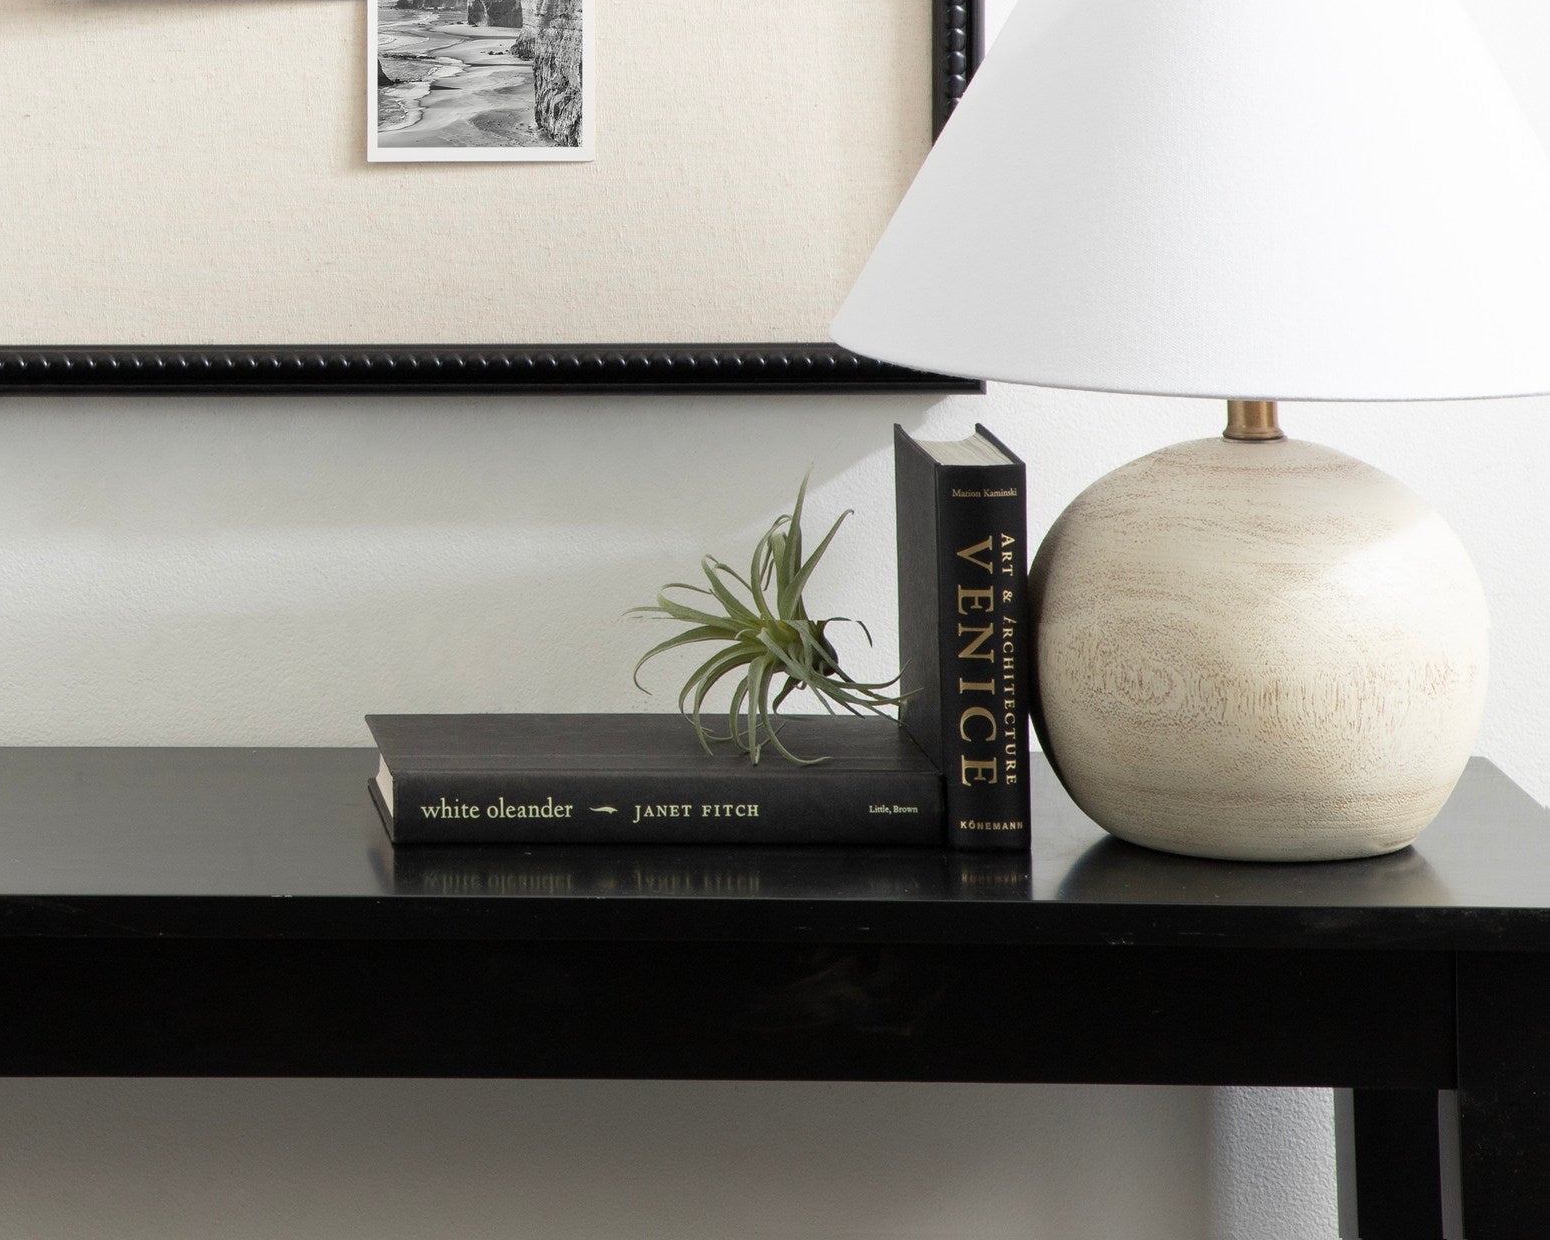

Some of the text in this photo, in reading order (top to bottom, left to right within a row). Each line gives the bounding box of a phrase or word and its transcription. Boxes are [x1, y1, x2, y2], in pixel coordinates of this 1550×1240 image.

[952, 487, 1018, 498] Marion Kaminski
[1000, 532, 1016, 577] ART
[1002, 589, 1014, 604] &
[956, 535, 998, 787] VENICE
[420, 796, 760, 824] white oleander JANET FITCH
[868, 804, 919, 815] Little, Brown
